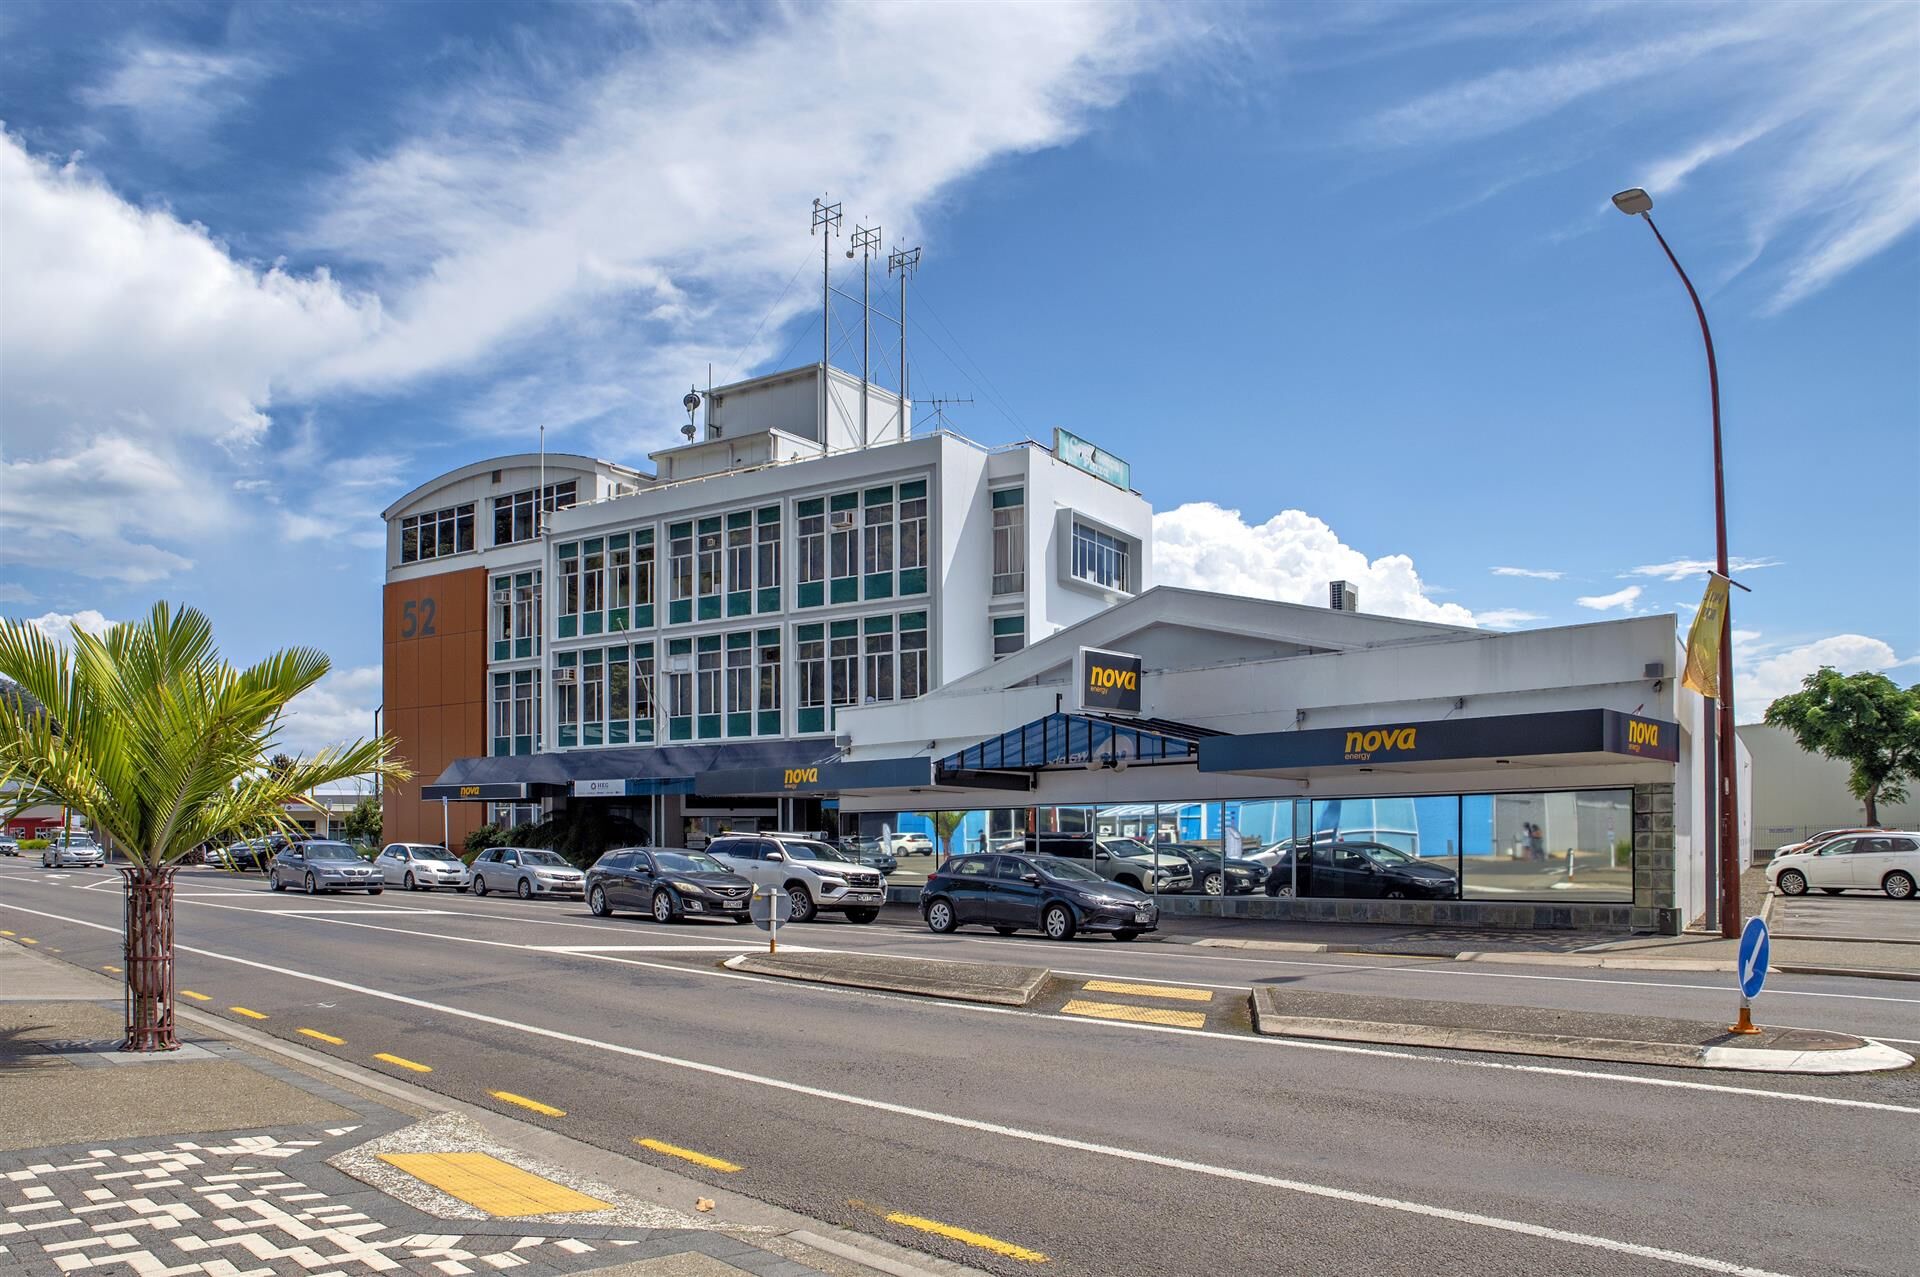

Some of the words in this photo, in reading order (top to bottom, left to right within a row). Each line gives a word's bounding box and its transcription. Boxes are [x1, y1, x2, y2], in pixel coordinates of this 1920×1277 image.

[402, 598, 436, 638] 52
[1091, 666, 1136, 690] nova
[1345, 728, 1416, 753] nova
[1629, 720, 1658, 746] nova
[1344, 753, 1371, 761] energy
[784, 768, 817, 784] nova
[461, 786, 480, 795] nova
